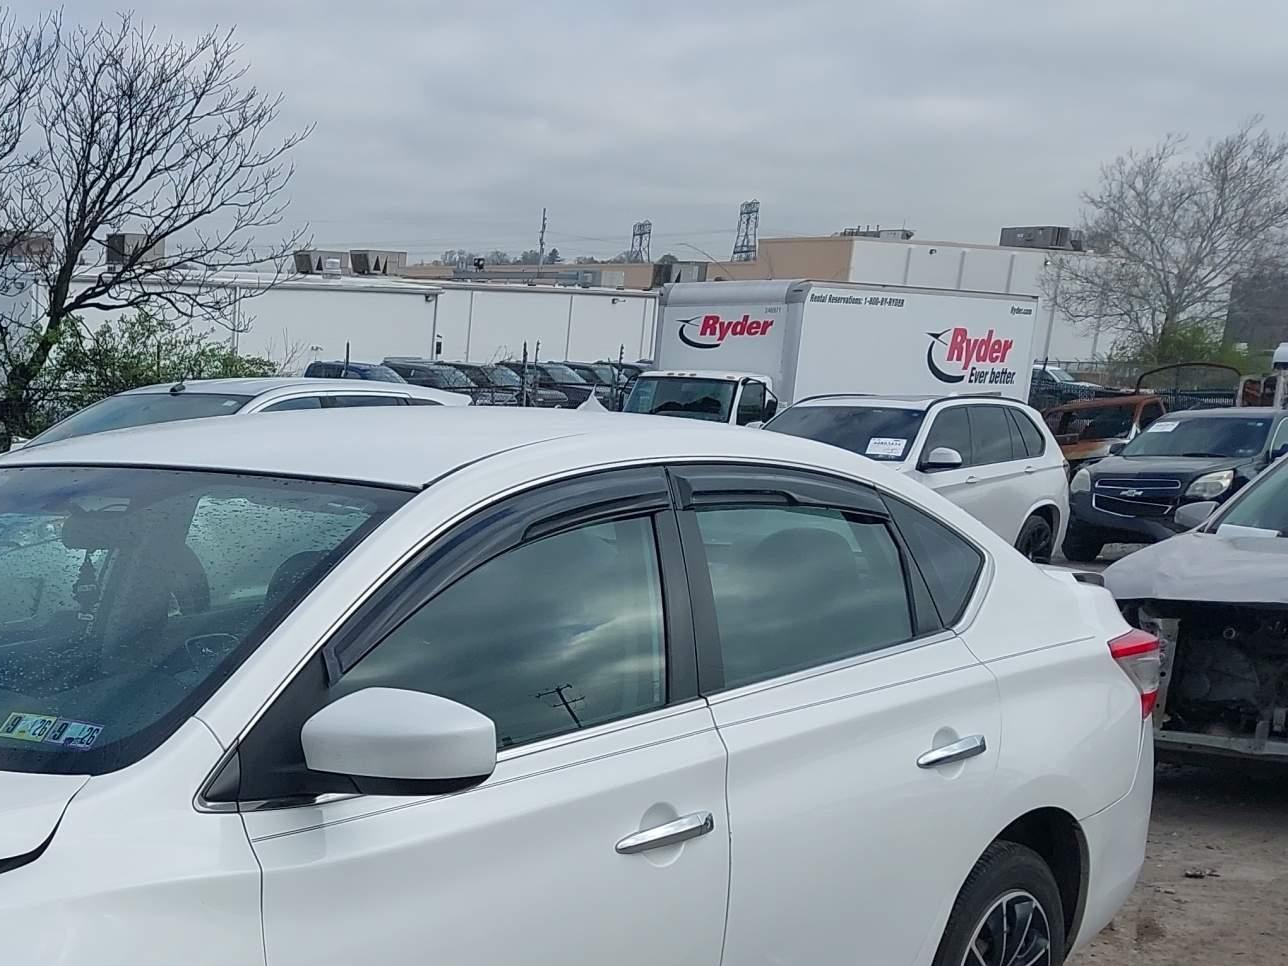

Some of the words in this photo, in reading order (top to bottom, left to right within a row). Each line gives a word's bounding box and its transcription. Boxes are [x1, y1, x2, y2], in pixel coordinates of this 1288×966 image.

[810, 293, 828, 303] Rental
[828, 294, 863, 305] Reservations:
[700, 315, 774, 341] Ryder
[946, 327, 1013, 370] Ryder
[968, 367, 989, 384] Ever
[7, 716, 23, 734] 9
[53, 722, 69, 741] 9
